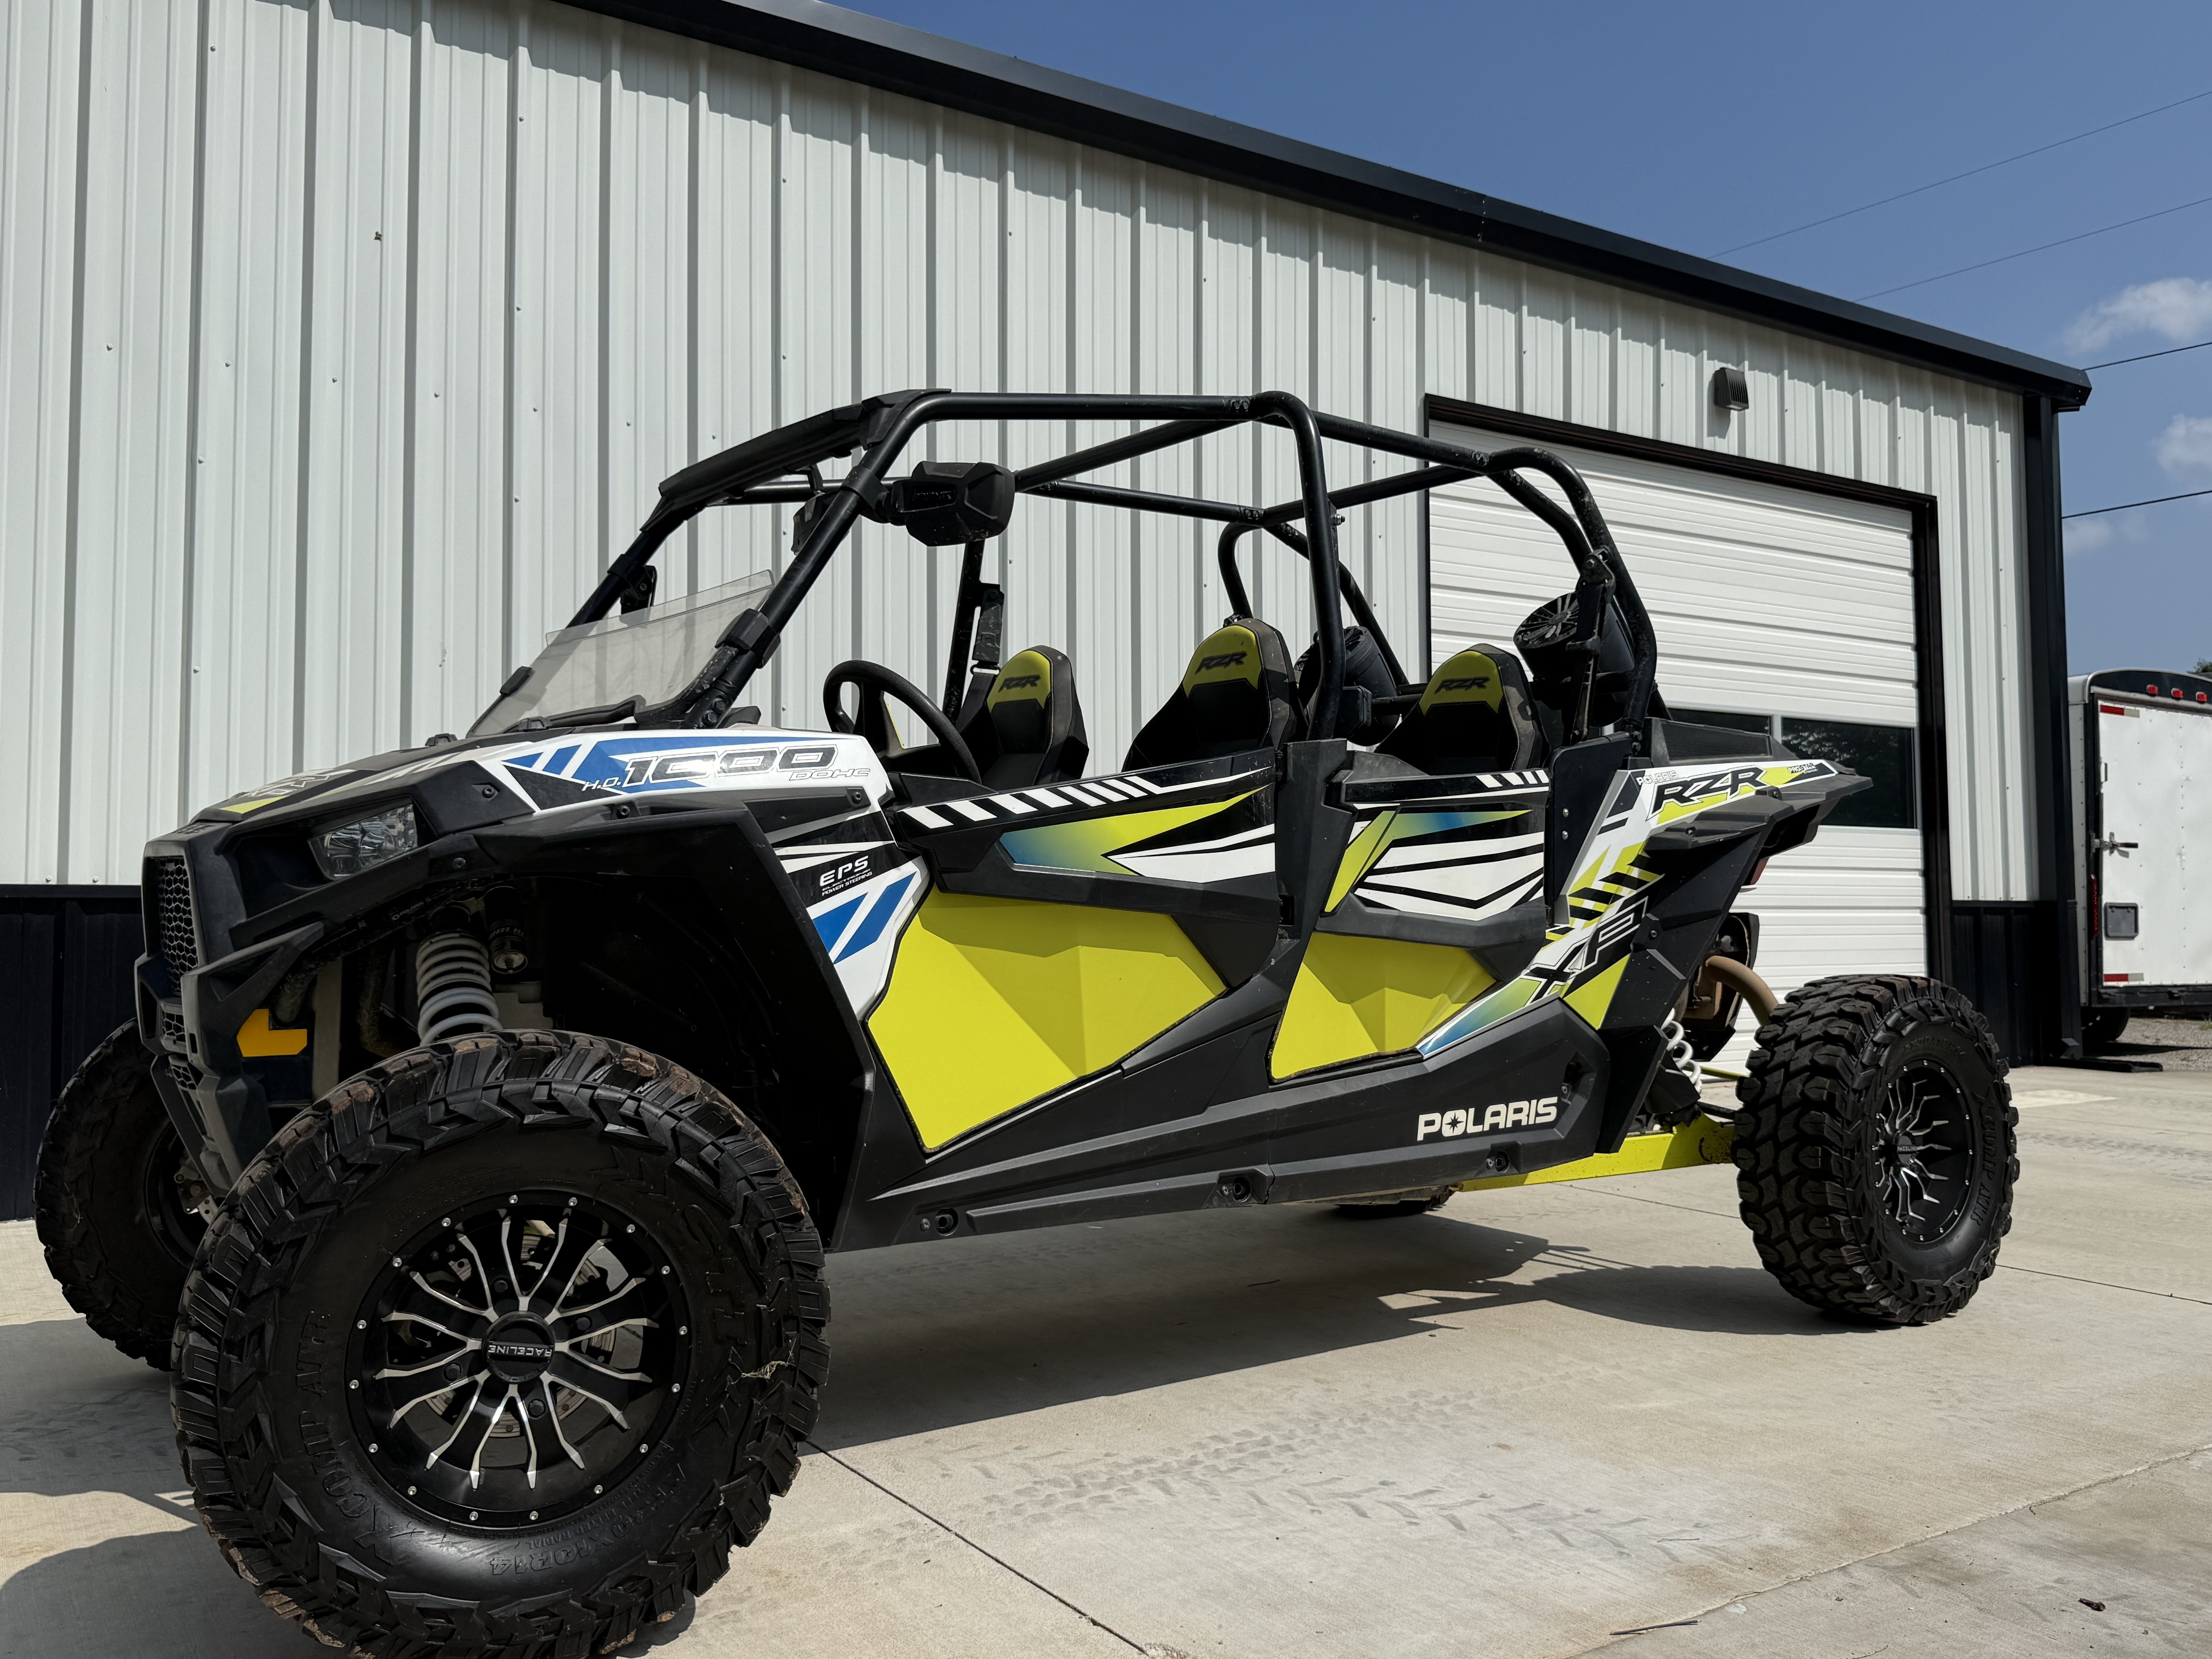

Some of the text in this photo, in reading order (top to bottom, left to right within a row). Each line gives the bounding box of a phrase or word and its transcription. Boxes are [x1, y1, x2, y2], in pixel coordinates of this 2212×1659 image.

[1195, 651, 1248, 674] RZR
[998, 675, 1041, 692] RZR
[1434, 676, 1490, 694] RZR
[622, 744, 838, 788] 1000
[789, 768, 871, 781] DOHC
[1636, 770, 1678, 785] POLARIS
[1647, 765, 1771, 821] RZR
[820, 855, 869, 886] EPS
[822, 883, 844, 896] POWER
[1417, 1096, 1558, 1141] POLARIS
[488, 1345, 553, 1357] RACELINE
